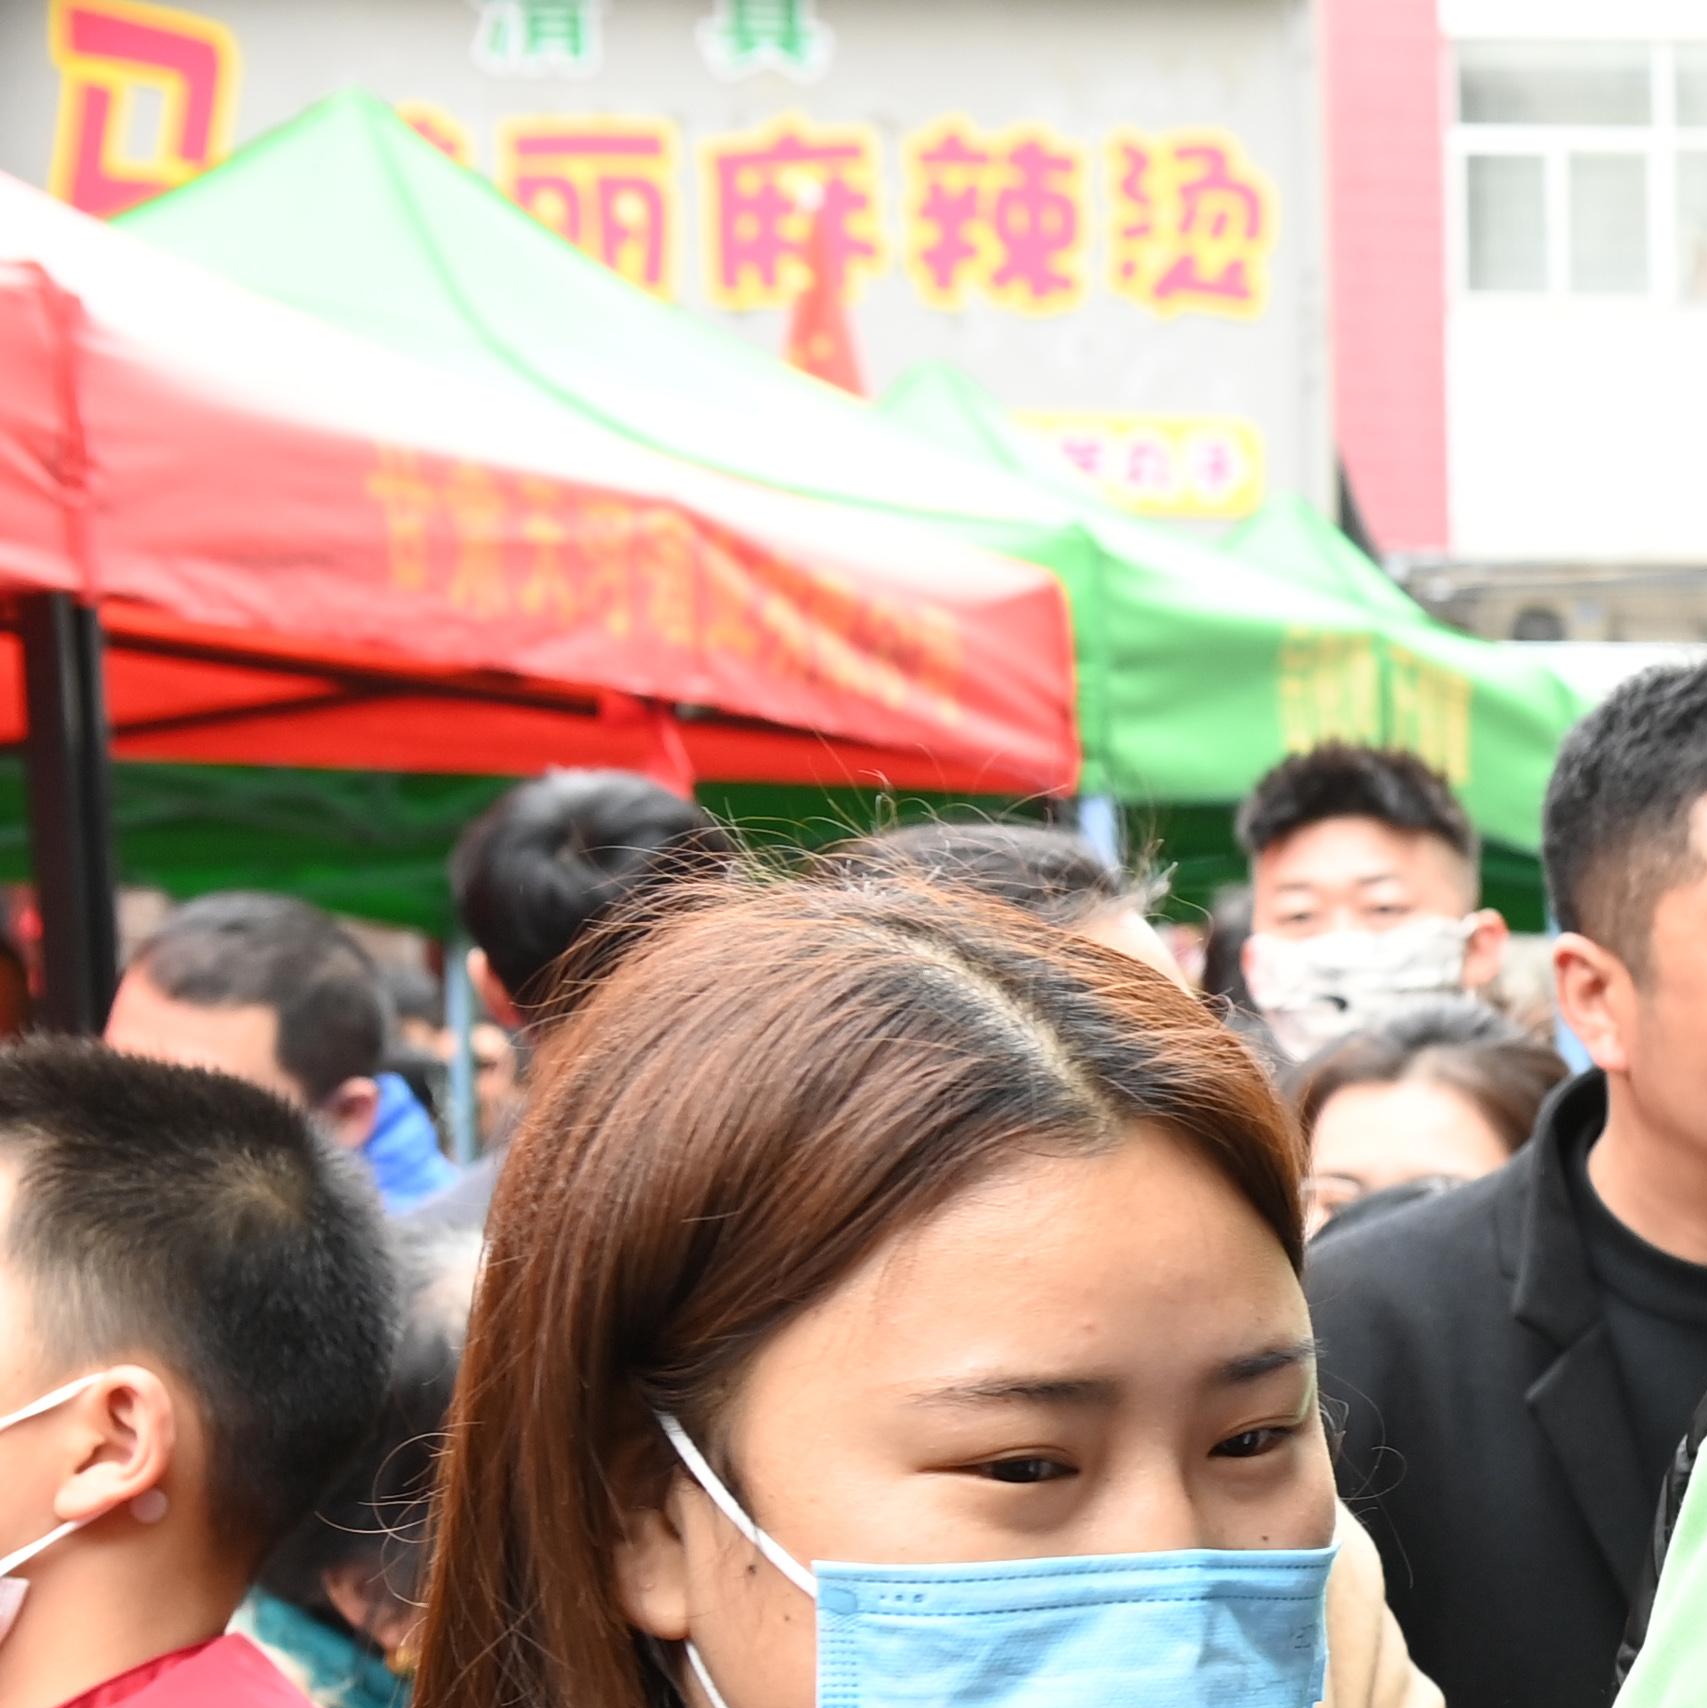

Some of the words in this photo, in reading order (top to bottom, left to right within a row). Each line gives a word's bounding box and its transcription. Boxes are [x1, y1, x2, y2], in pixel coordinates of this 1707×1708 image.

[52, 0, 1268, 316] 马丽麻辣烫
